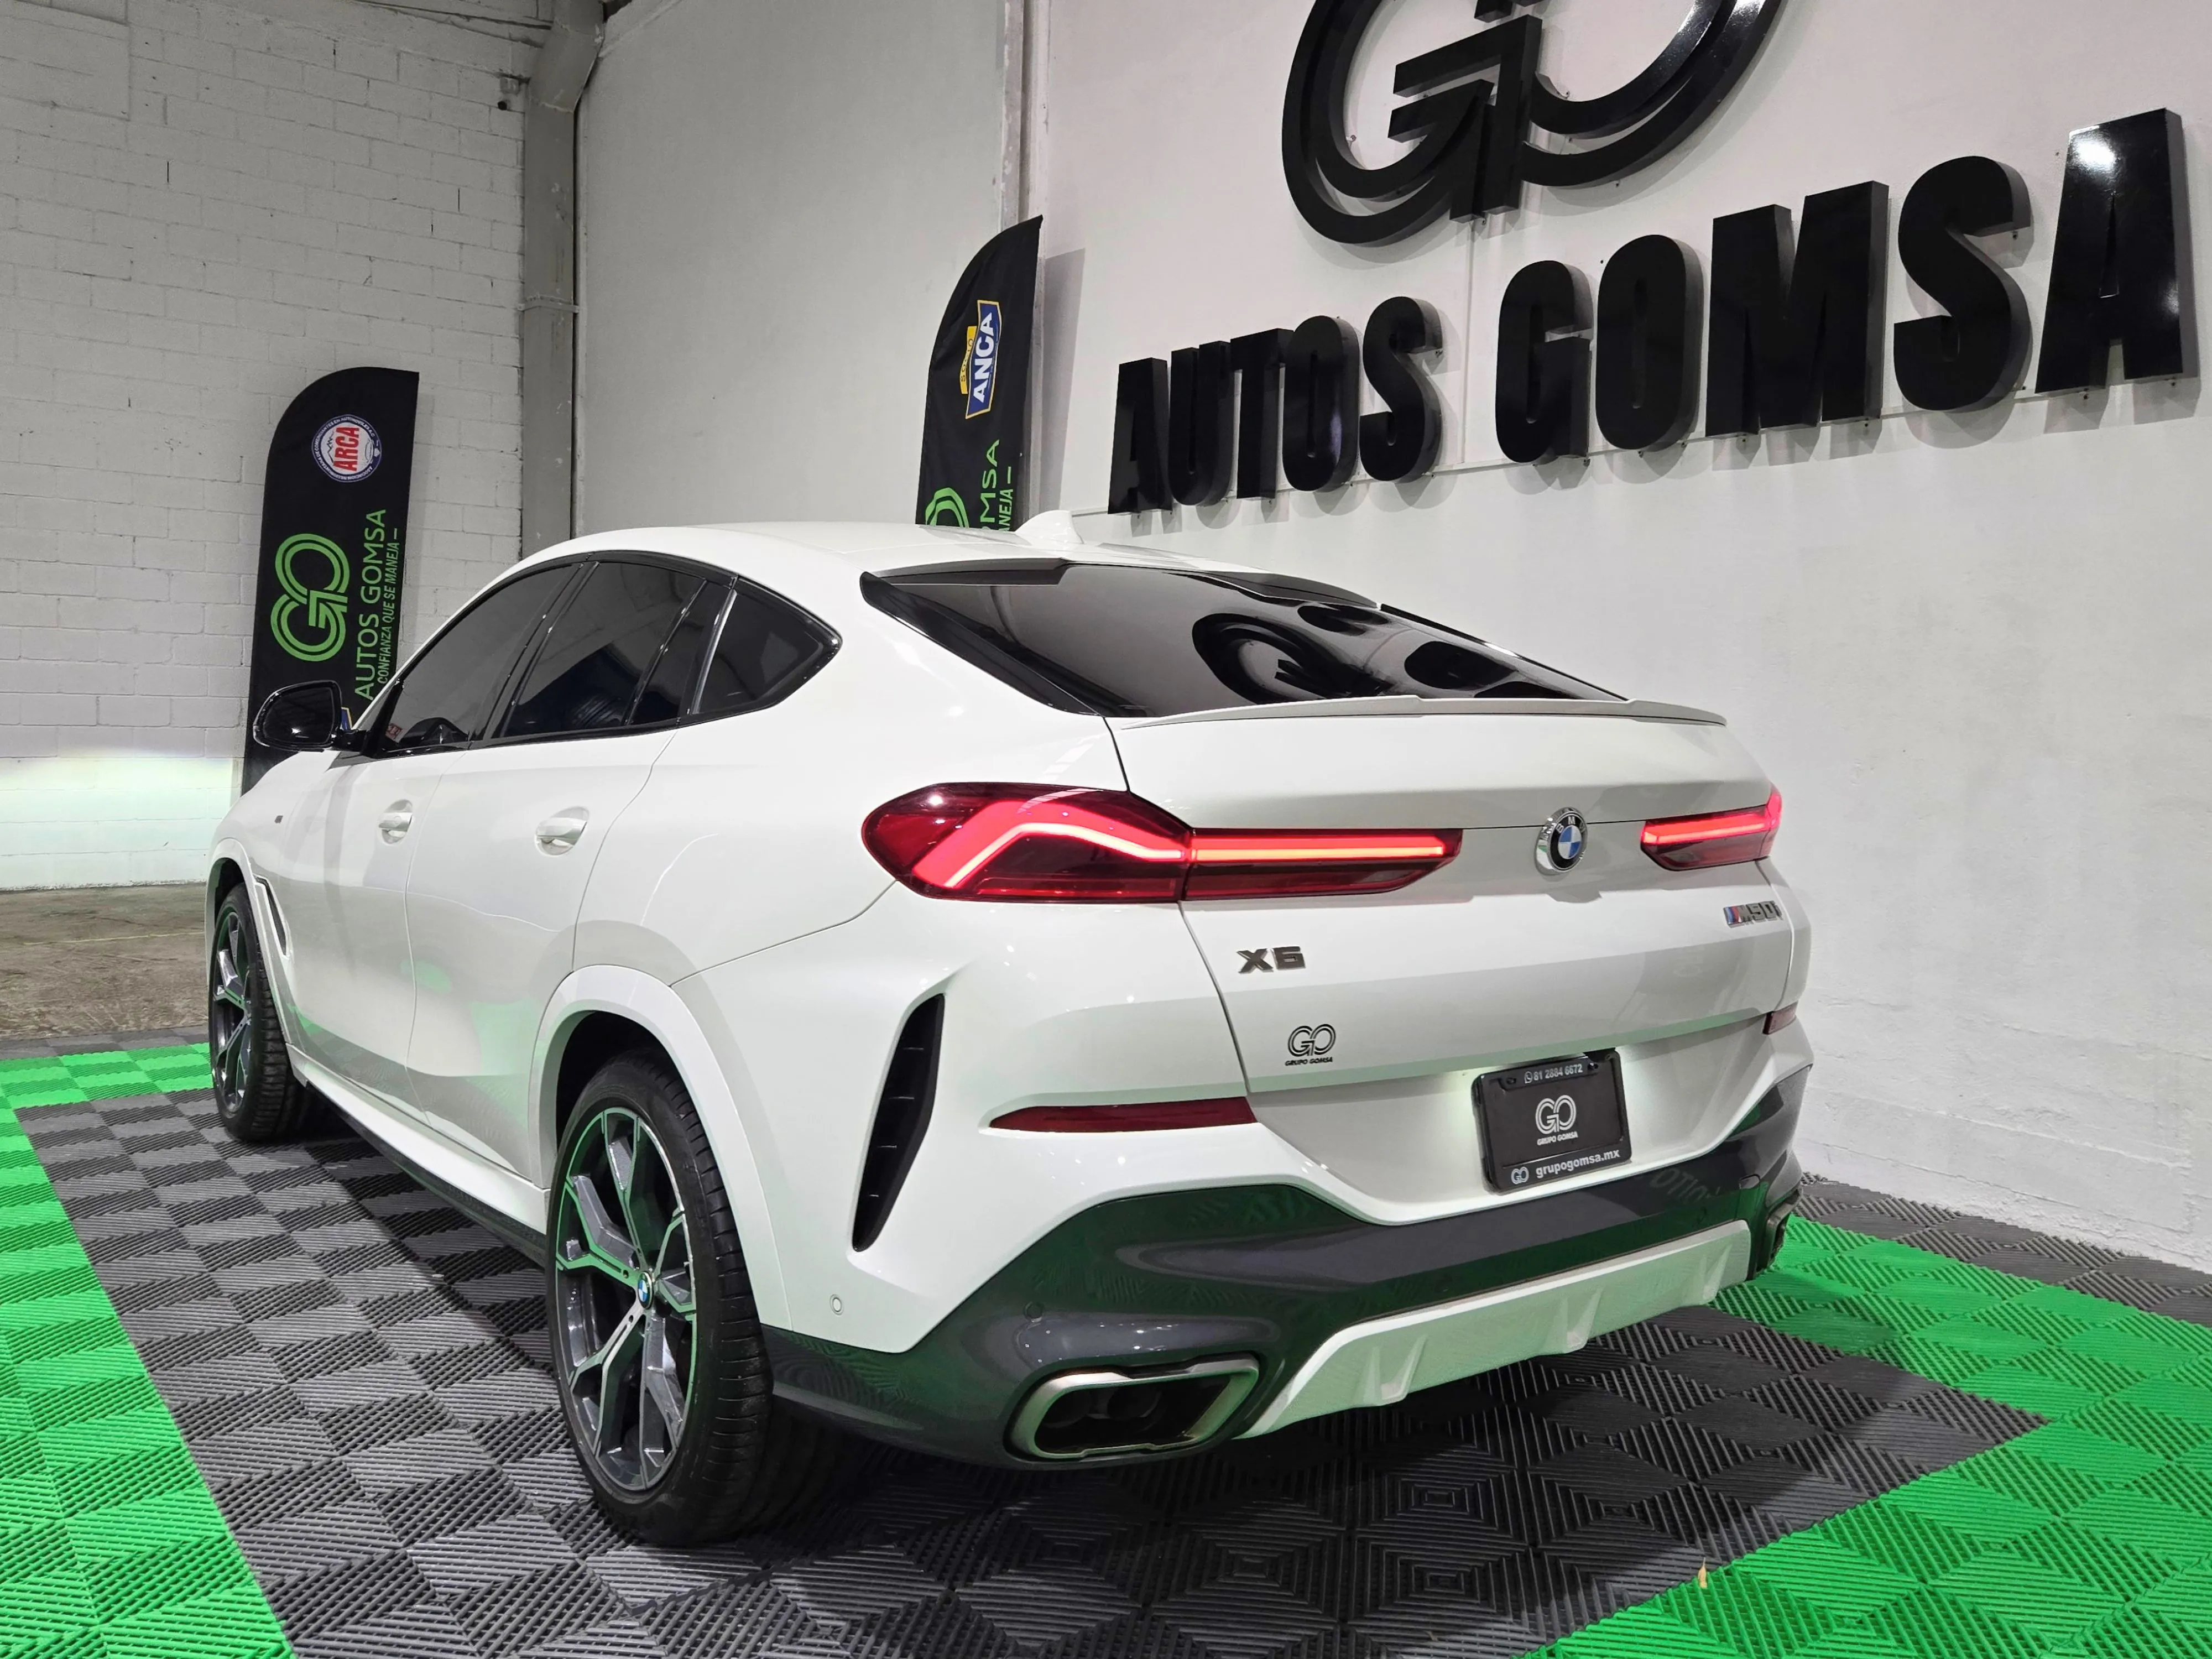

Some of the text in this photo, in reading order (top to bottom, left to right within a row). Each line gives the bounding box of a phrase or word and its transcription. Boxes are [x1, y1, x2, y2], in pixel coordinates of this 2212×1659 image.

[1108, 108, 2197, 515] AUTOS GOMSA
[973, 312, 994, 403] ANCA
[333, 427, 359, 472] ARCA
[354, 509, 387, 701] AUTOS GOMSA
[377, 542, 400, 684] CONFIANZA QUE SE MANEJA
[1236, 946, 1306, 974] X6
[1533, 1070, 1543, 1081] 81
[1545, 1067, 1563, 1079] 2884
[1537, 1131, 1578, 1146] GRUPO GOMSA
[1536, 1150, 1620, 1178] grupogomsa.mx
